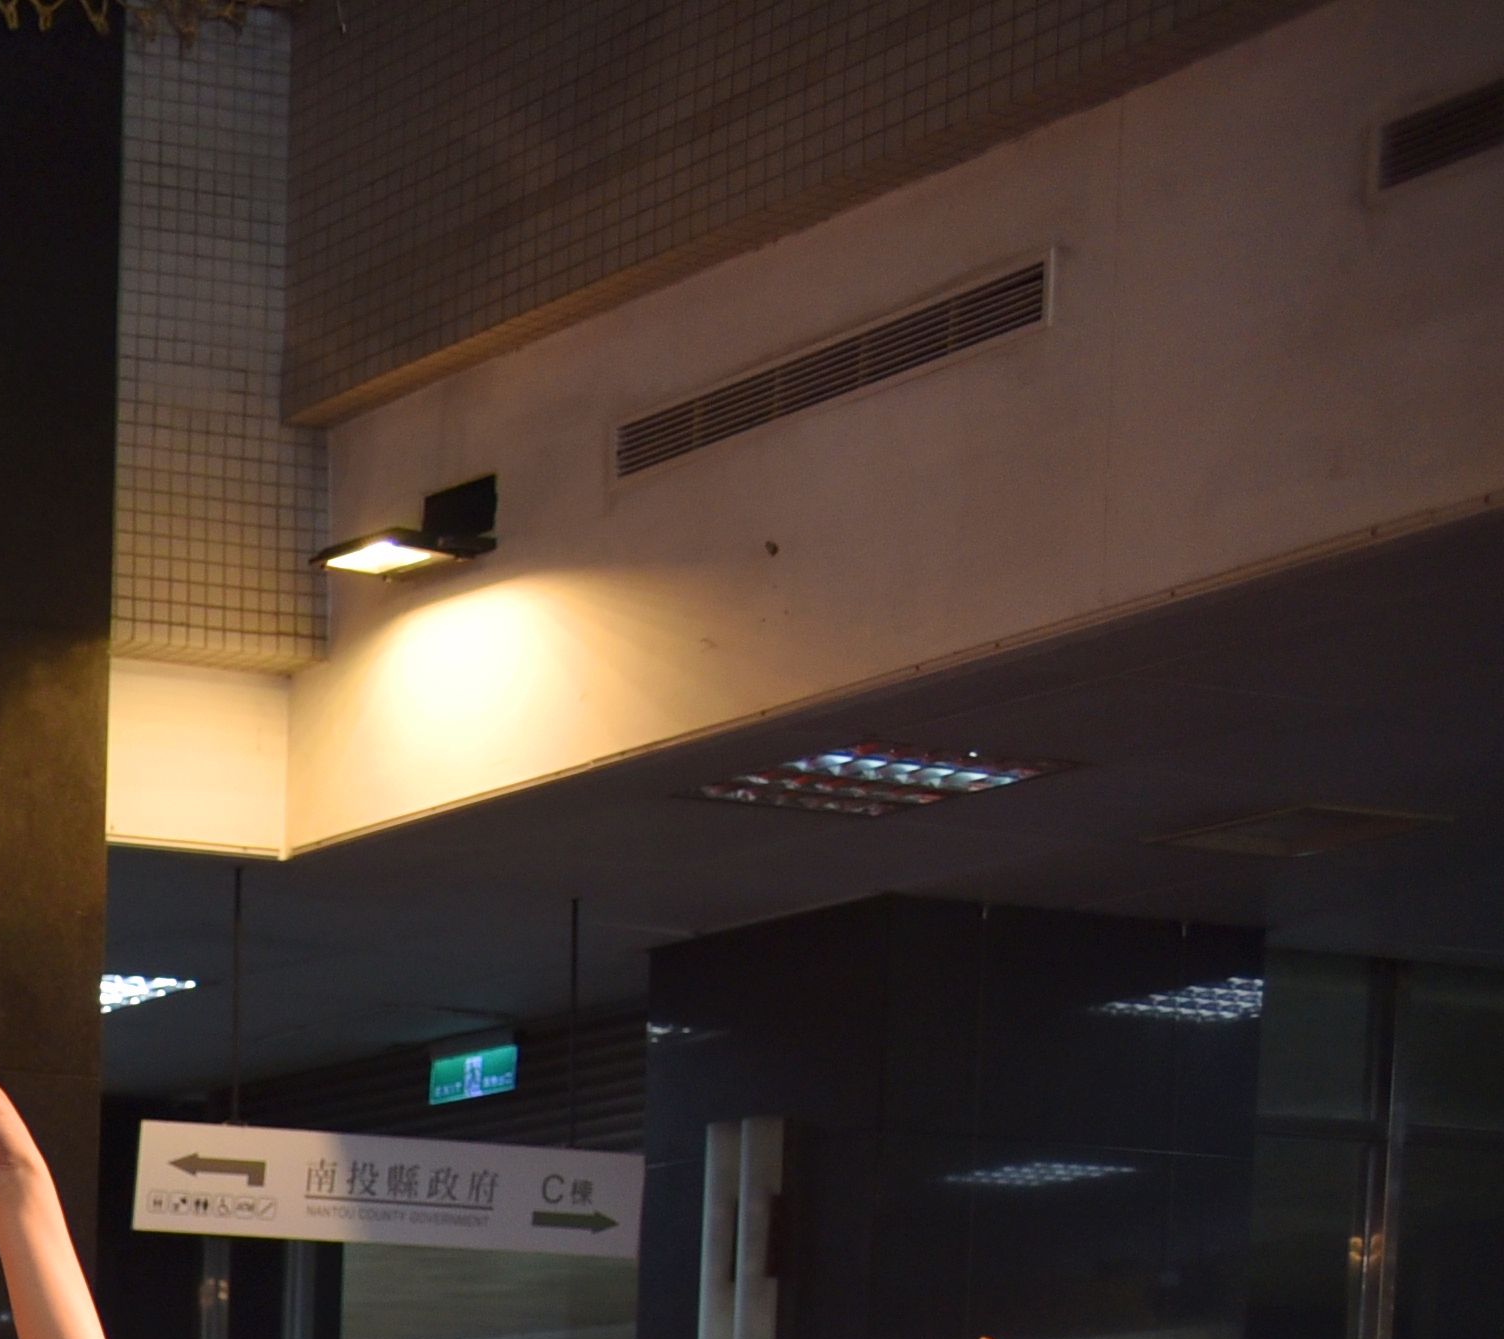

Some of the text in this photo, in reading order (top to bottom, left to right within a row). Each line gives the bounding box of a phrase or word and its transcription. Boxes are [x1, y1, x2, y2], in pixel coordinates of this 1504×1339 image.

[305, 1159, 499, 1203] 南投縣政府
